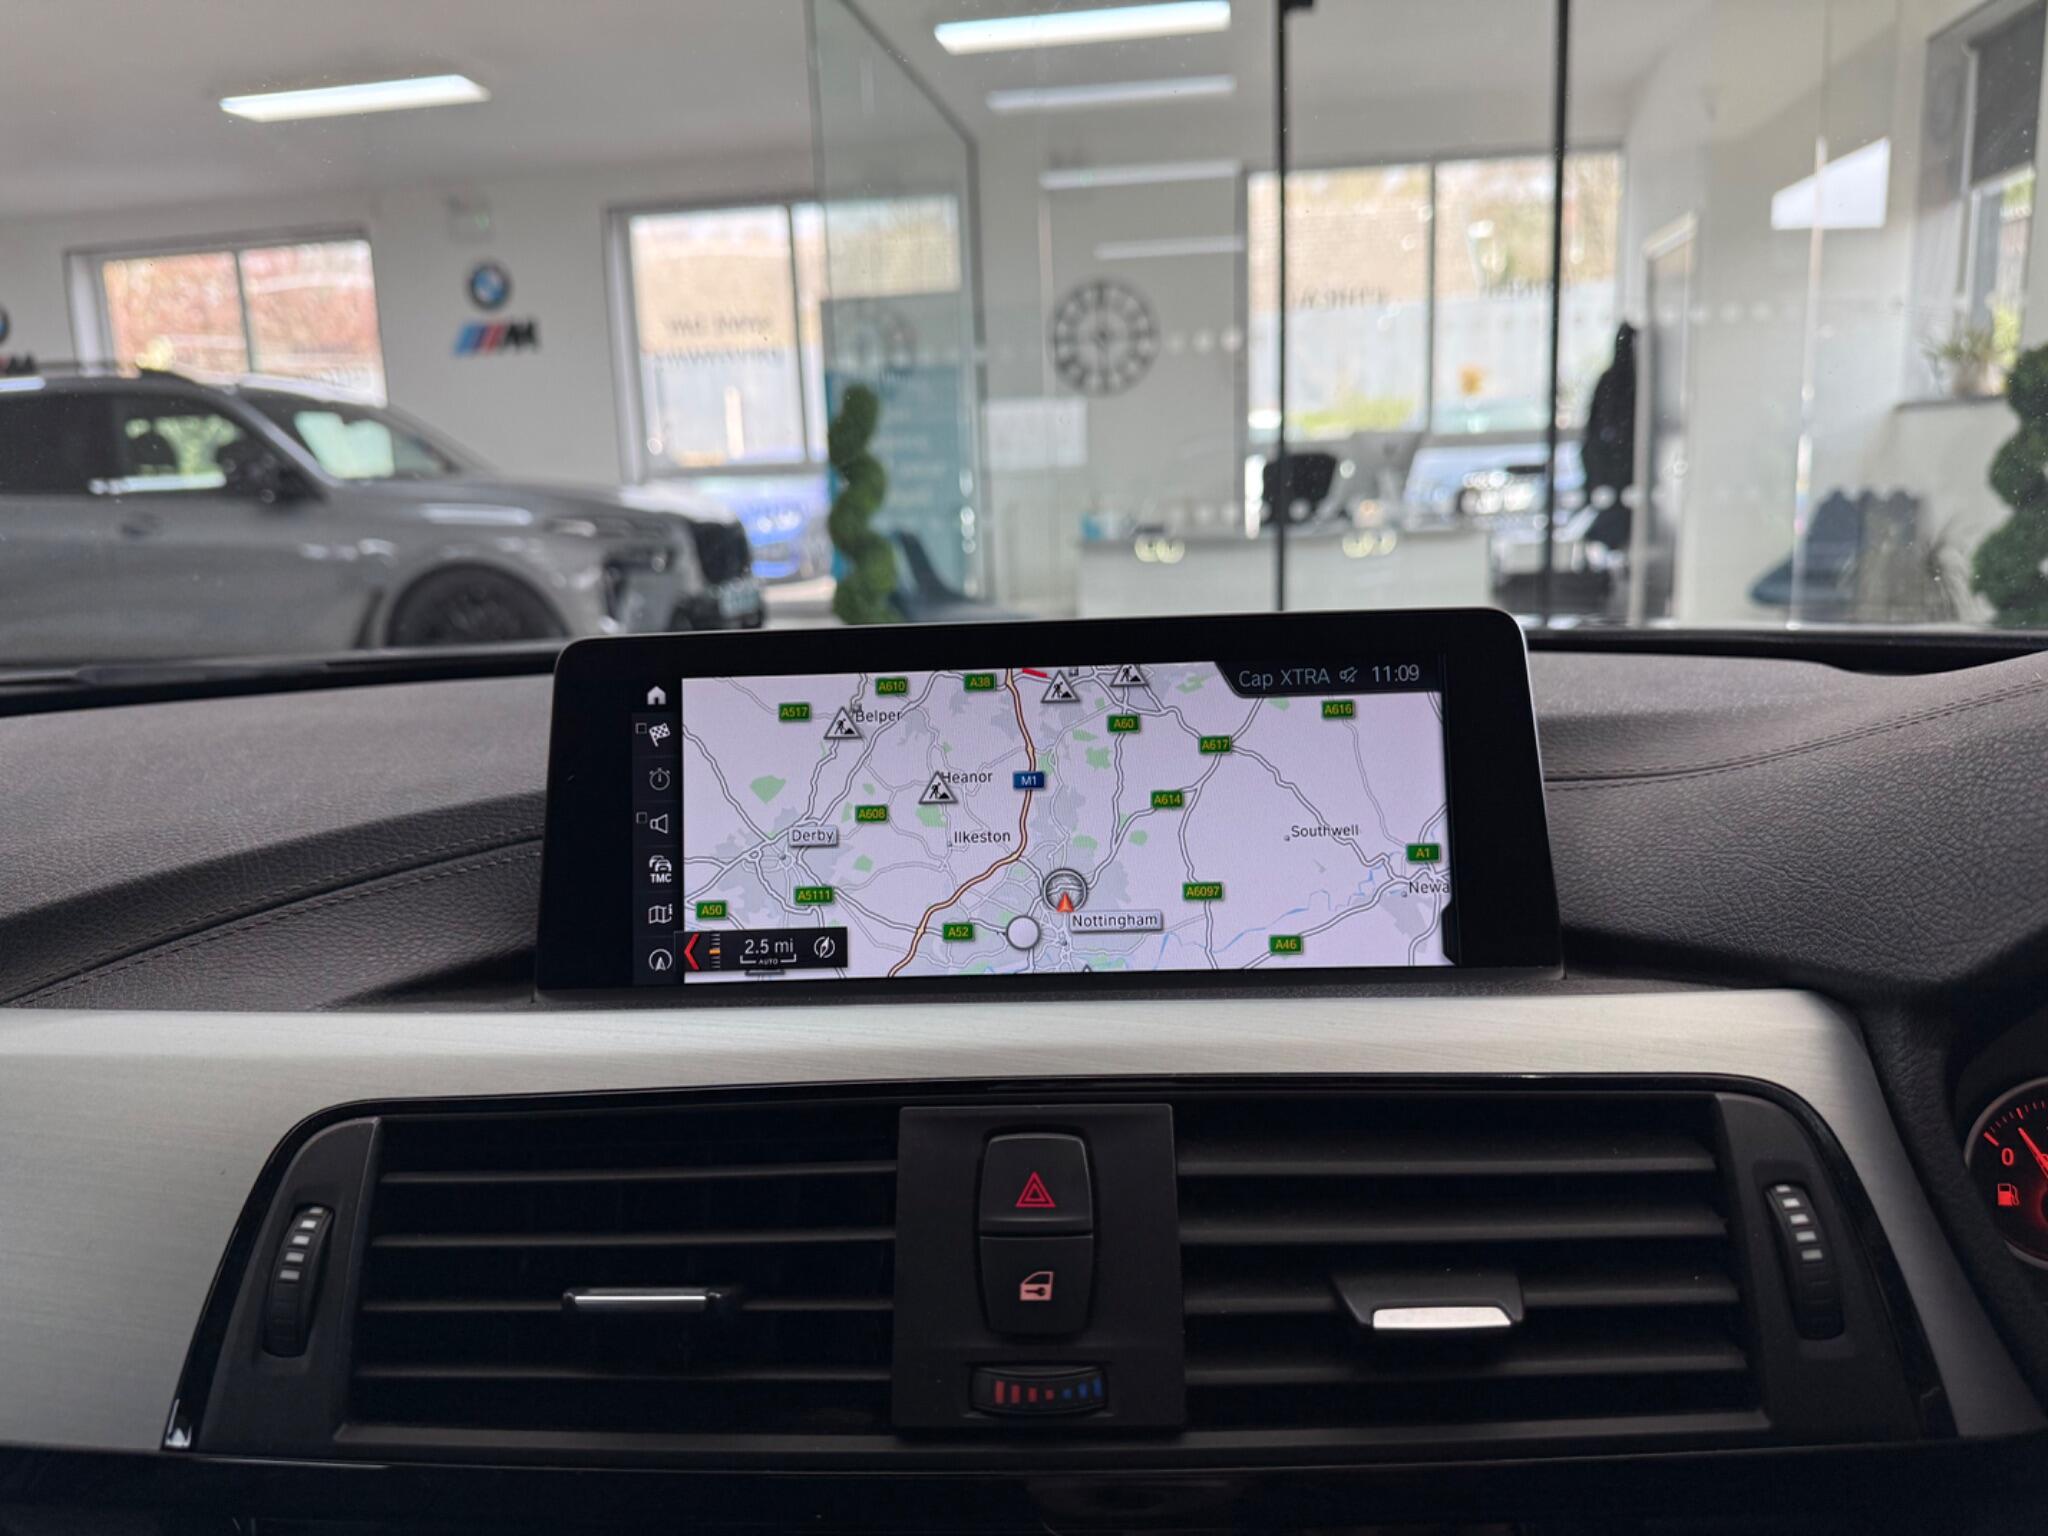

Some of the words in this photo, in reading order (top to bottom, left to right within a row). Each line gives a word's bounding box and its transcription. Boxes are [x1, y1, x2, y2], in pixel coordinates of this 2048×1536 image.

[1239, 671, 1273, 689] Cap
[1280, 668, 1331, 686] XTRA
[1372, 664, 1420, 682] 11:09
[878, 680, 906, 693] A610
[969, 676, 991, 688] A38
[780, 706, 808, 718] A517
[1324, 703, 1352, 716] A616
[855, 710, 901, 725] Belper
[1113, 718, 1135, 730] A60
[1201, 738, 1229, 751] A617
[941, 771, 993, 784] Heanor
[1020, 775, 1037, 787] M1
[1154, 793, 1182, 805] A614
[858, 808, 886, 820] A608
[791, 827, 834, 843] Derby
[954, 830, 1011, 844] Ilkeston
[1290, 824, 1360, 839] Southwell
[1415, 848, 1431, 859] A1
[650, 873, 673, 884] TMC
[797, 890, 832, 901] A5111
[1186, 885, 1220, 897] A6097
[701, 904, 723, 916] A50
[1072, 914, 1158, 930] Nottingham
[947, 926, 970, 938] A52
[744, 938, 770, 955] 2.5
[774, 938, 794, 953] mi
[1275, 938, 1297, 950] A46
[2001, 1147, 2015, 1167] 0
